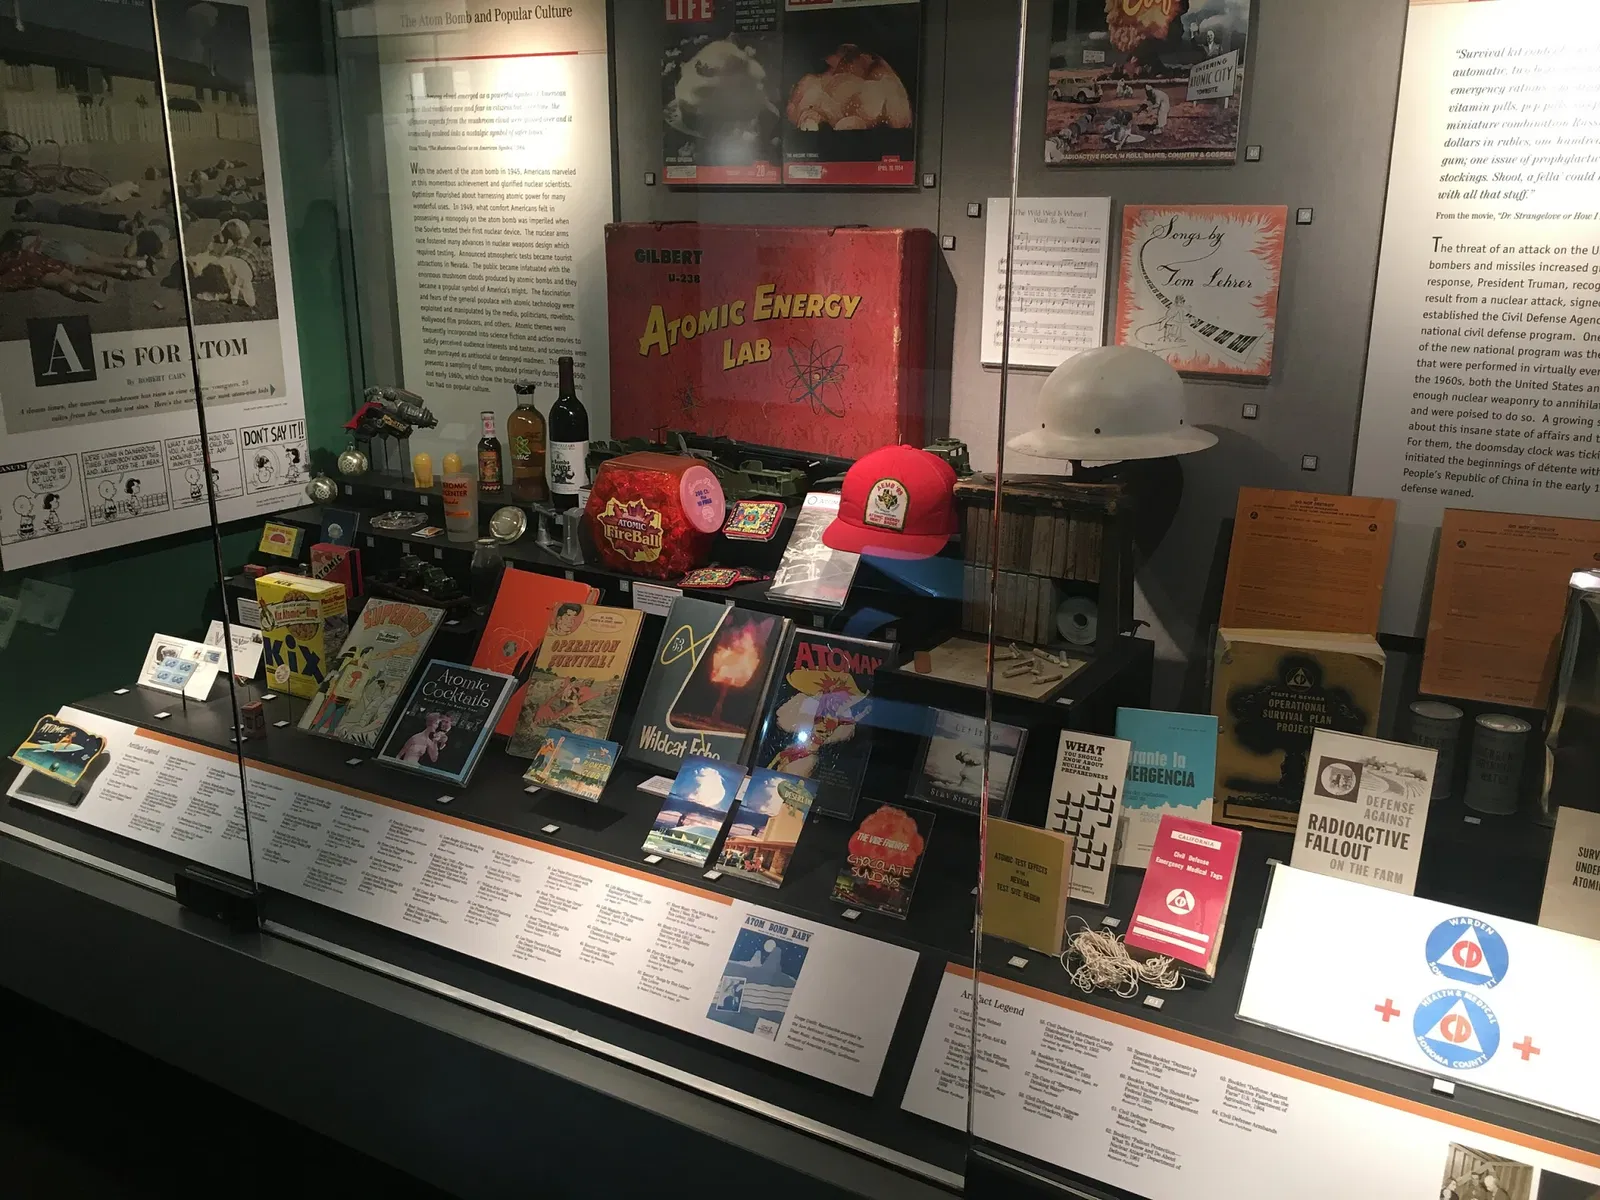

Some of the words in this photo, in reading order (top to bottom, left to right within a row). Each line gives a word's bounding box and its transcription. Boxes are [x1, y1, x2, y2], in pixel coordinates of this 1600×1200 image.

[400, 14, 416, 28] The
[419, 14, 444, 26] Atom
[446, 11, 472, 25] Bomb
[474, 8, 492, 23] and
[494, 6, 532, 24] Popular
[535, 5, 572, 19] Culture
[666, 0, 712, 20] LIFE
[1195, 58, 1227, 72] ENTERING
[1190, 70, 1213, 87] ATOMIC
[1214, 67, 1232, 82] CITY
[410, 162, 425, 175] With
[1438, 190, 1460, 199] with
[1463, 189, 1478, 199] all
[1480, 189, 1501, 199] that
[1152, 214, 1203, 246] Songs
[1210, 226, 1225, 247] by
[1432, 236, 1452, 253] The
[1456, 244, 1486, 253] threat
[1489, 244, 1500, 253] of
[1502, 246, 1515, 254] an
[1518, 245, 1550, 254] attack
[1554, 246, 1567, 255] on
[1570, 245, 1588, 255] the
[634, 249, 703, 264] GILBERT
[1429, 261, 1470, 270] bombers
[1474, 261, 1492, 271] and
[1496, 261, 1536, 271] missiles
[1539, 262, 1588, 272] increased
[668, 273, 700, 283] U-238
[1156, 264, 1194, 288] Tom
[1202, 267, 1254, 289] Lehrer
[639, 300, 746, 357] ATOMIC
[753, 283, 862, 321] ENERGY
[42, 322, 90, 376] A
[102, 349, 125, 370] IS
[135, 344, 181, 366] FOR
[723, 338, 771, 371] LAB
[138, 375, 165, 385] ROBERT
[244, 428, 270, 446] DON'T
[271, 425, 286, 442] SAY
[1401, 483, 1437, 495] defense
[1440, 488, 1474, 498] waned.
[618, 519, 646, 530] ATOMIC
[607, 525, 661, 548] FireBall
[315, 555, 343, 580] ATOMIC
[364, 603, 433, 638] SUPERBOY
[551, 640, 621, 652] OPERATION
[263, 634, 325, 685] Kix
[548, 655, 615, 668] SURVIVAL!
[794, 642, 882, 675] ATOMAN
[437, 668, 490, 691] Atomic
[423, 681, 490, 708] Cocktails
[1269, 699, 1326, 713] OPERATIONAL
[1262, 709, 1304, 722] SURVIVAL
[1310, 714, 1332, 725] PLAN
[39, 723, 67, 733] ATOMIC
[1276, 722, 1315, 734] PROJECT
[639, 725, 687, 758] Wildcat
[1065, 740, 1105, 756] WHAT
[584, 760, 611, 771] PIONEER
[1062, 762, 1090, 771] NUCLEAR
[1078, 752, 1102, 762] SHOULD
[1083, 760, 1104, 768] ABOUT
[583, 770, 600, 779] CLUB
[1061, 767, 1108, 780] PREPAREDNESS
[1126, 766, 1195, 788] MERGENCIA
[1366, 795, 1415, 815] DEFENSE
[1364, 808, 1412, 828] AGAINST
[857, 832, 870, 842] THE
[1178, 834, 1214, 847] CALIFORNIA
[1308, 813, 1410, 850] RADIOACTIVE
[1305, 832, 1372, 862] FALLOUT
[847, 854, 912, 877] CHOCOLATE
[994, 852, 1014, 864] ATOMIC
[1015, 858, 1027, 867] TEST
[1028, 862, 1048, 875] EFFECTS
[1156, 856, 1184, 870] Emergency
[1186, 865, 1207, 876] Medical
[1210, 871, 1223, 880] Tags
[1174, 851, 1186, 860] Civil
[1188, 855, 1210, 866] Defense
[851, 867, 900, 887] SUNDAYS
[1010, 876, 1030, 887] NEVADA
[1330, 858, 1344, 871] ON
[1349, 862, 1370, 877] THE
[1374, 868, 1404, 885] FARM
[997, 883, 1009, 892] TEST
[1010, 887, 1021, 897] SITE
[1024, 891, 1041, 904] REGION
[1572, 876, 1600, 891] ATOMI
[745, 916, 765, 928] ATOM
[769, 923, 789, 935] BOMB
[792, 930, 812, 942] BABY
[1449, 917, 1494, 936] WARDEN
[994, 1000, 1025, 1016] Legend
[1421, 989, 1454, 1007] HEALTH
[1464, 992, 1497, 1025] MEDICAL
[1417, 1035, 1449, 1066] SONOMA
[1453, 1053, 1488, 1069] COUNTY
